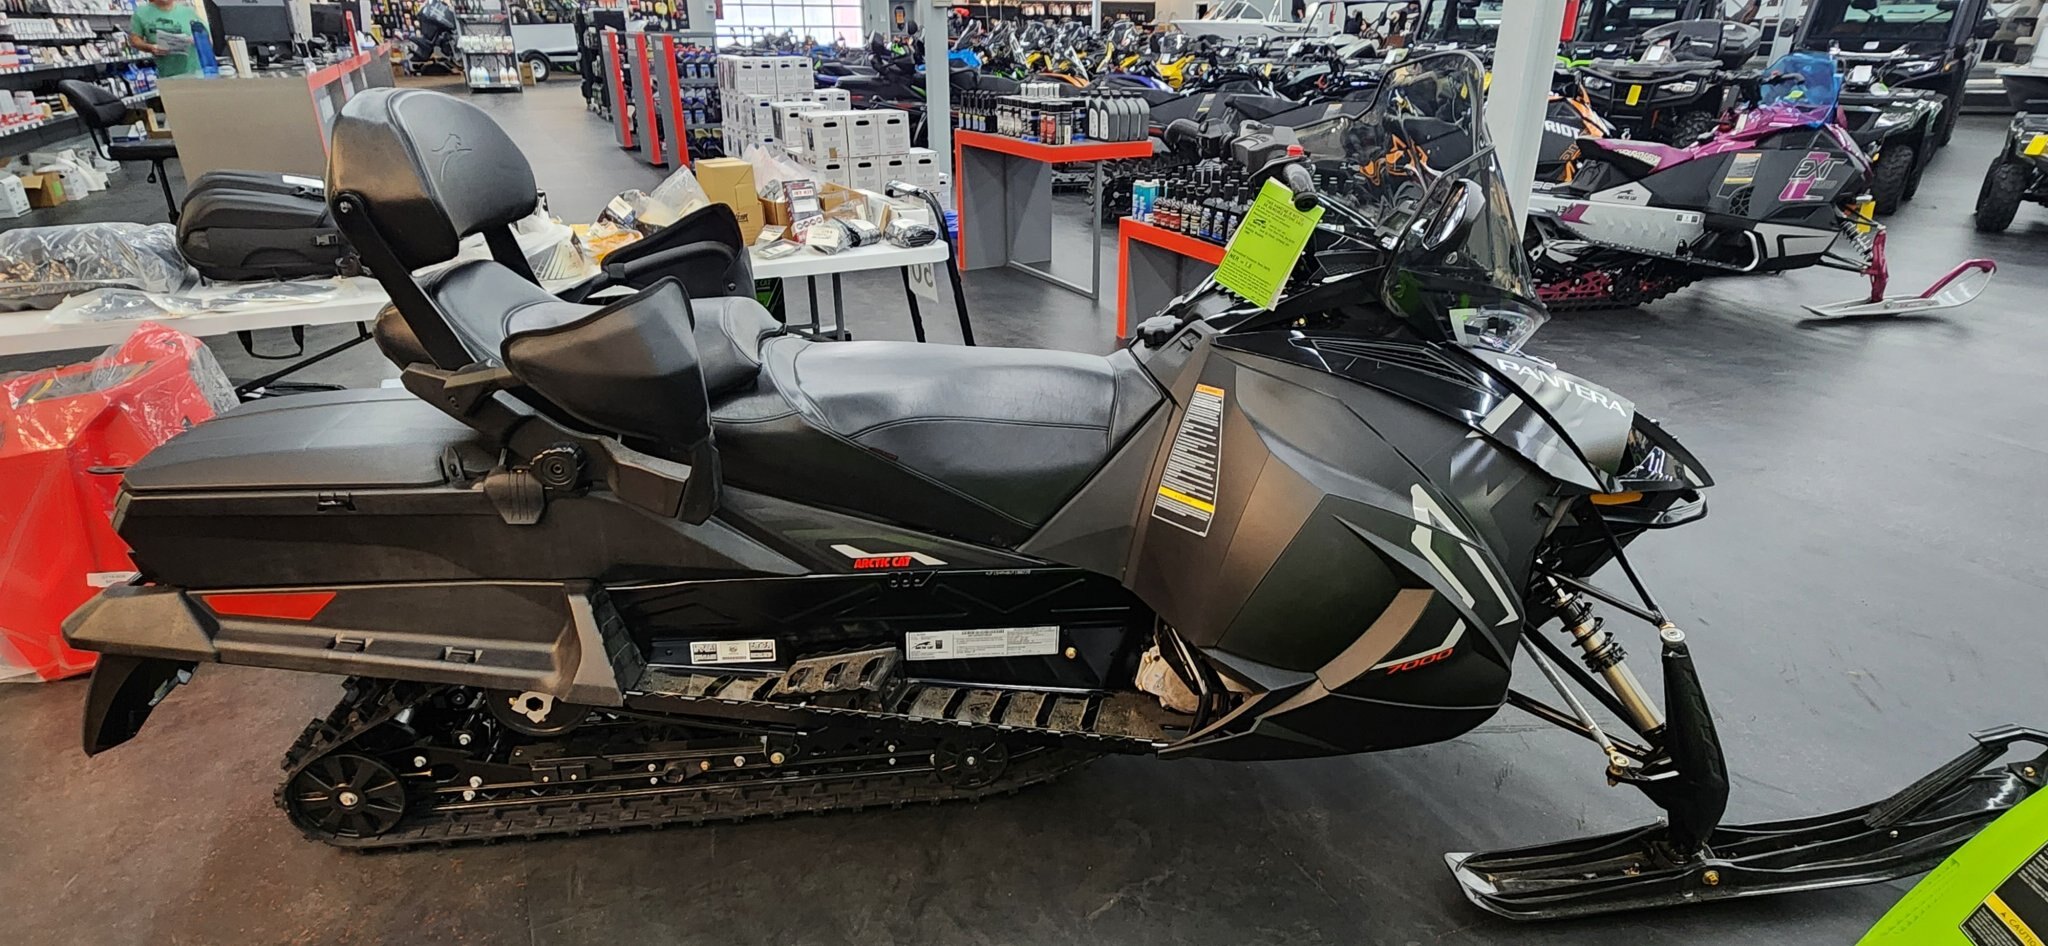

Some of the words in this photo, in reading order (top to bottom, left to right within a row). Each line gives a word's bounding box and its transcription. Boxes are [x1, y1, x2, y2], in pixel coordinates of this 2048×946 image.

[1545, 120, 1580, 140] RIOT
[1789, 157, 1848, 181] EXT
[1496, 358, 1627, 418] PANTERA
[854, 557, 890, 569] ARCTIC
[891, 555, 912, 567] CAT
[1386, 648, 1454, 675] 7000
